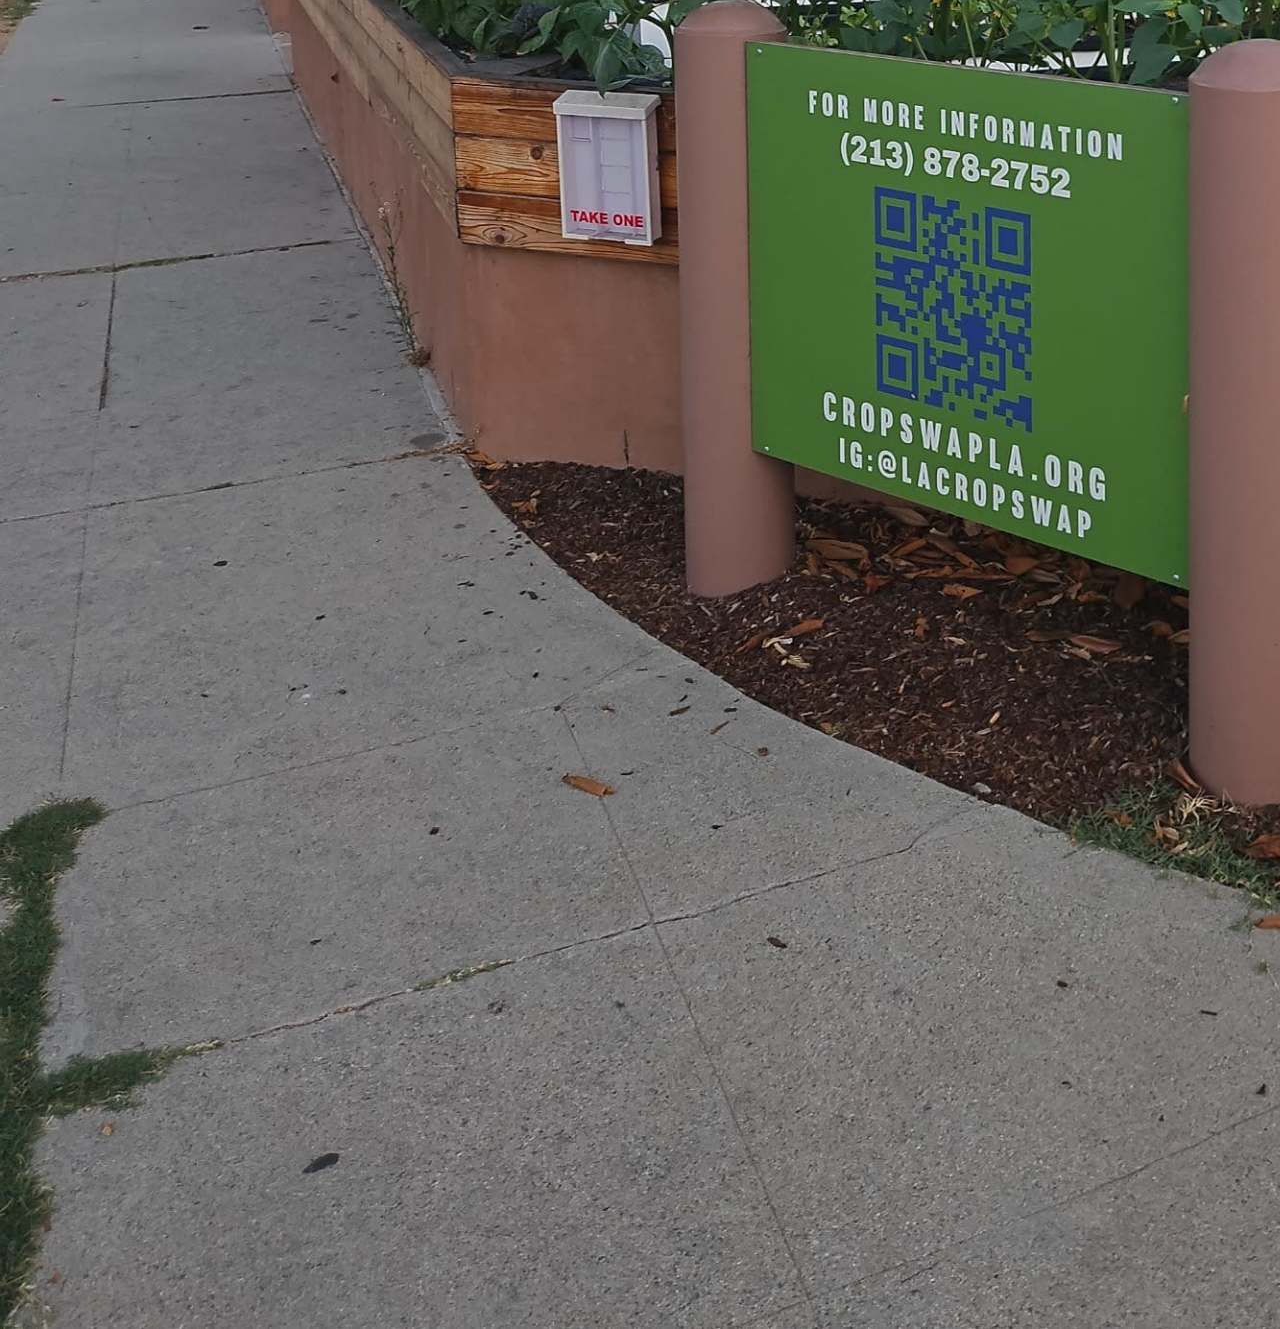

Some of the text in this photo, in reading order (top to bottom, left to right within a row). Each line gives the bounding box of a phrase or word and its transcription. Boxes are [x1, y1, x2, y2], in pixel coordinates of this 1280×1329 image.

[808, 90, 1123, 161] FOR MORE INFORMATION
[840, 132, 1071, 199] (213) 878-2752
[570, 209, 644, 228] TAKE ONE
[823, 391, 1106, 502] CROPSWAPLA.ORG
[839, 437, 1092, 539] IG:@LACROPSWAP
